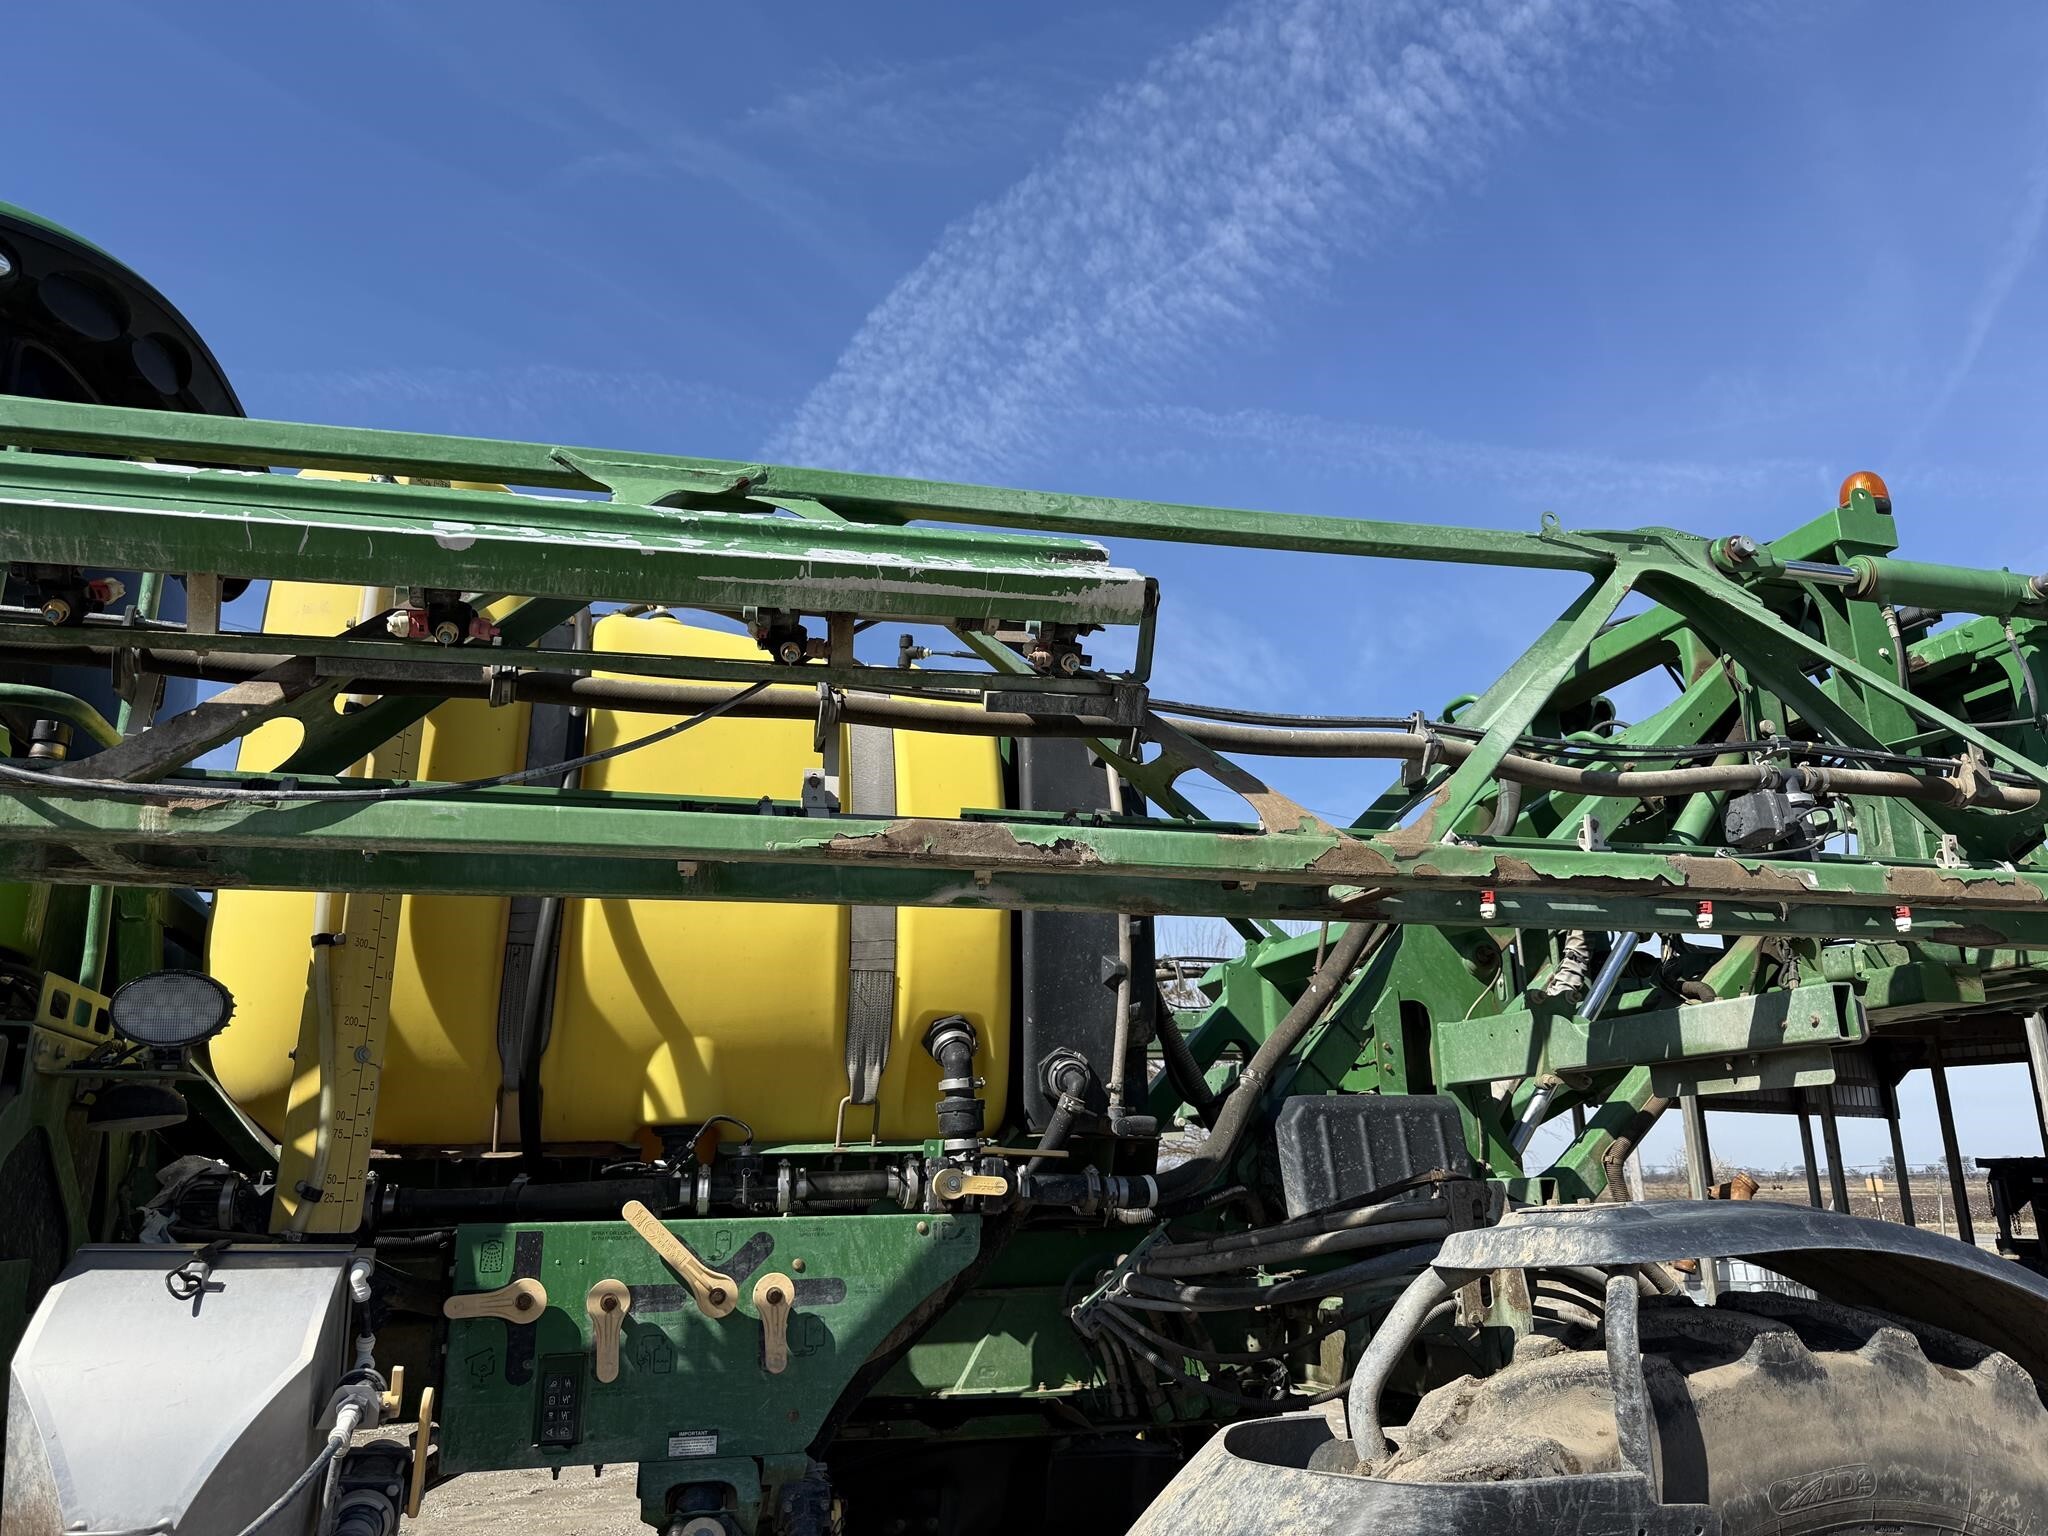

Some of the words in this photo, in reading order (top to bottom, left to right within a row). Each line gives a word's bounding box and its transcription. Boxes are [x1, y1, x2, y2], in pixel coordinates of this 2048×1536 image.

[355, 937, 369, 949] 300
[344, 1016, 359, 1027] 200
[369, 1081, 375, 1091] 5
[366, 1106, 371, 1117] 4
[333, 1128, 344, 1139] 75
[362, 1127, 369, 1138] 3
[326, 1174, 337, 1185] 50
[357, 1169, 363, 1180] 2
[323, 1193, 335, 1204] 25
